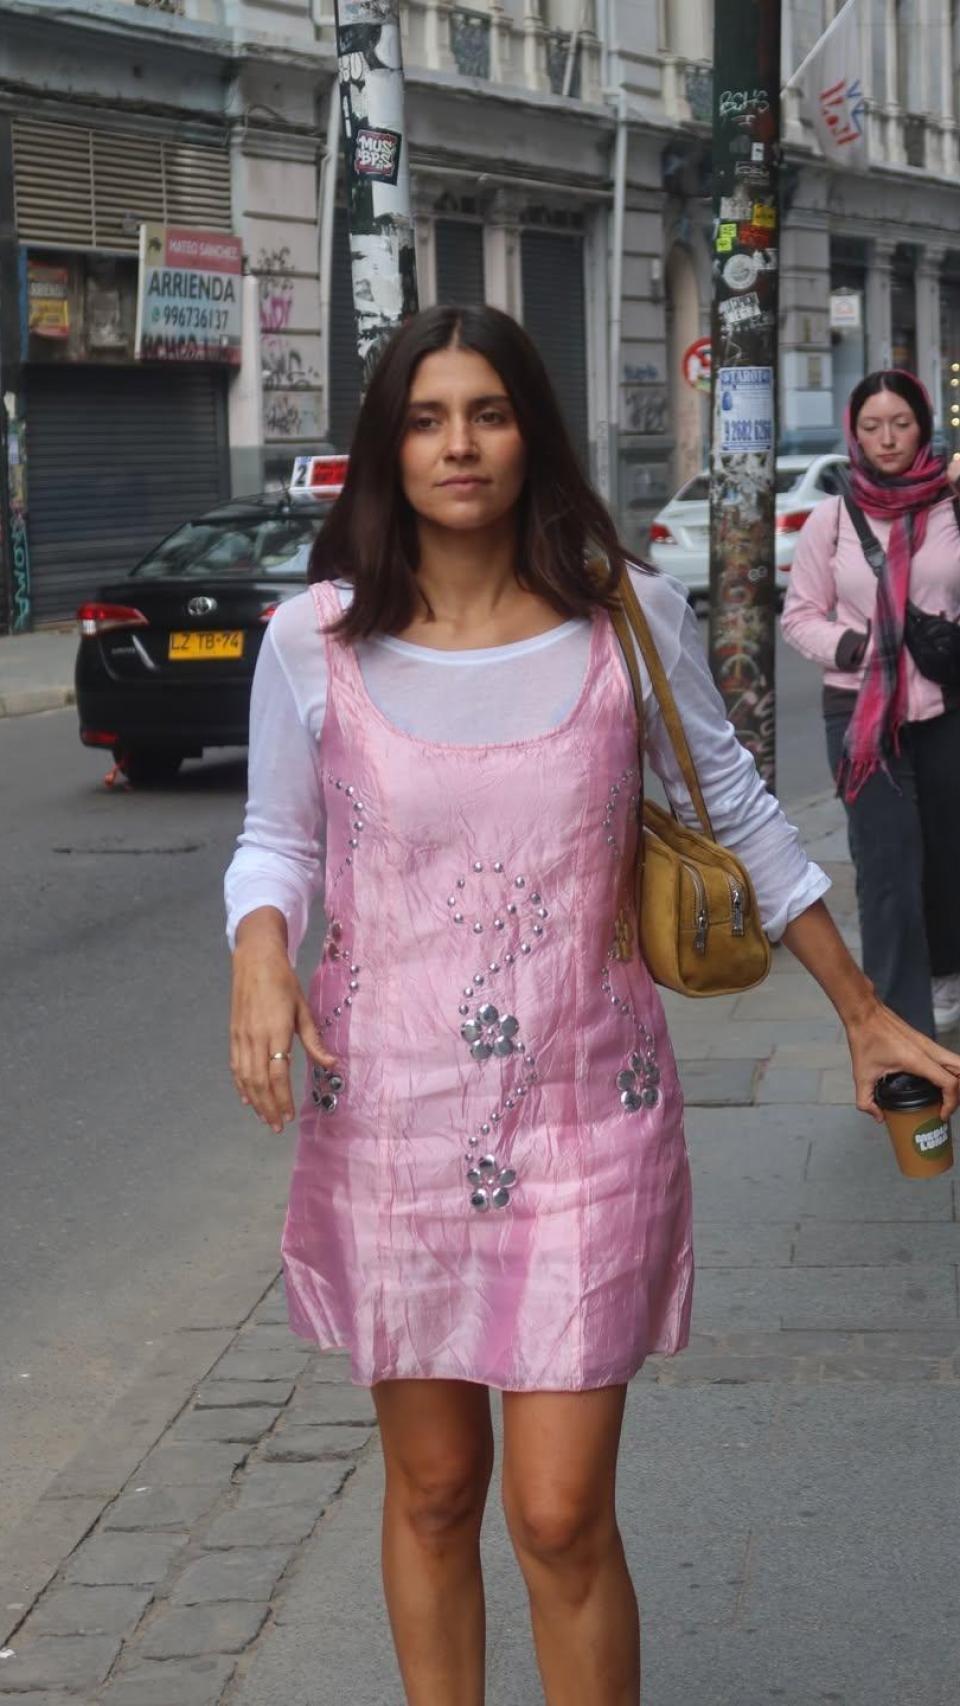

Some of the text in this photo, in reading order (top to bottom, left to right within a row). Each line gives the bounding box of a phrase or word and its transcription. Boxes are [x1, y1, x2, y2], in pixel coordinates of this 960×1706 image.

[148, 270, 236, 303] ARRIENDA
[163, 303, 229, 330] 996736137
[294, 463, 308, 487] 2
